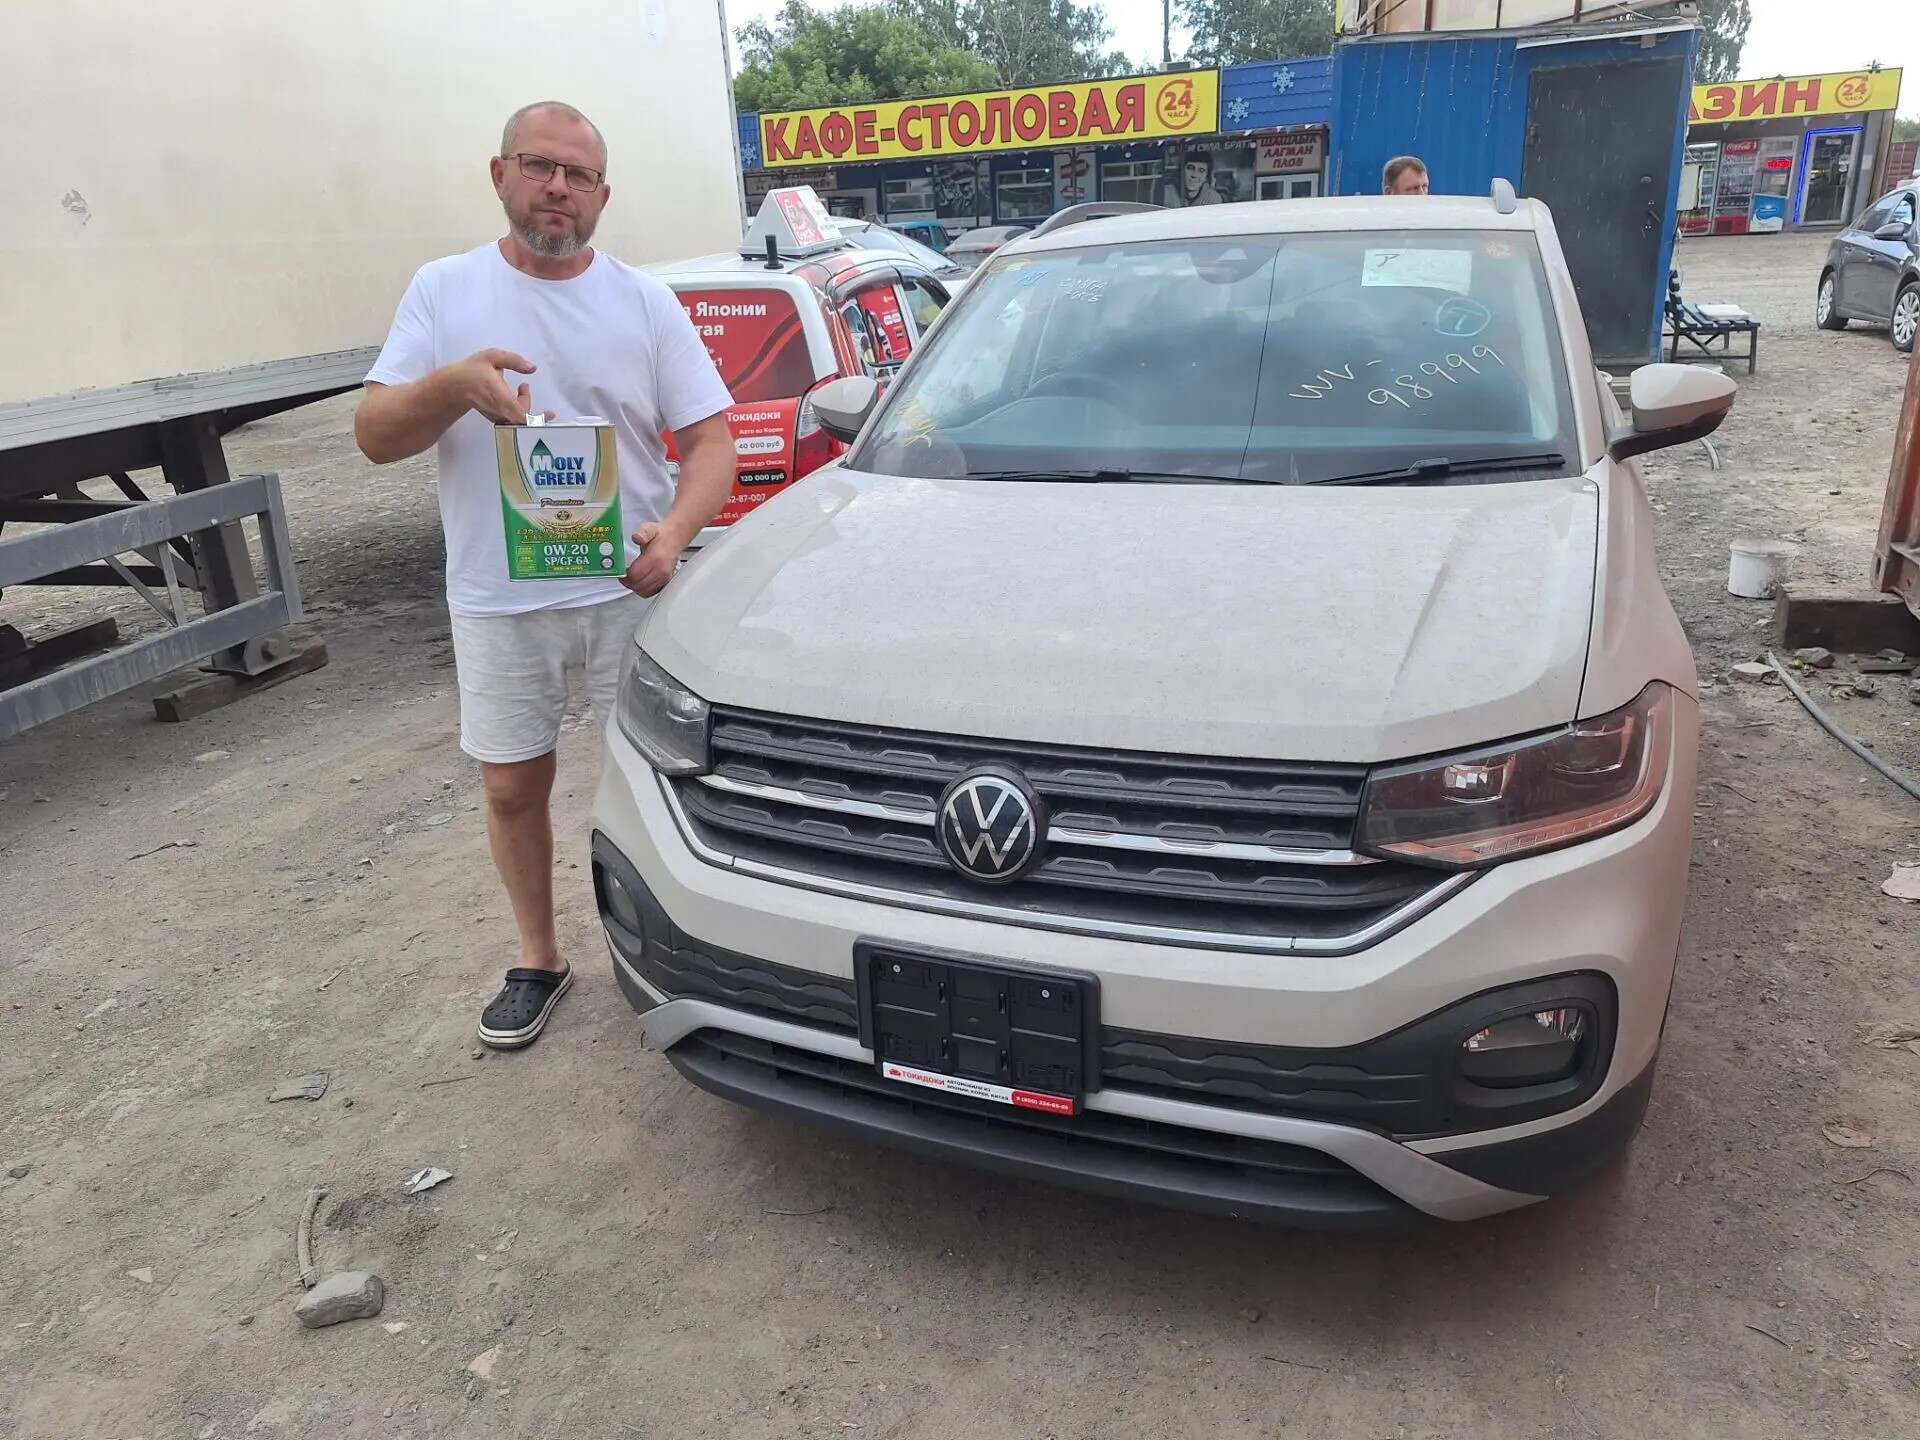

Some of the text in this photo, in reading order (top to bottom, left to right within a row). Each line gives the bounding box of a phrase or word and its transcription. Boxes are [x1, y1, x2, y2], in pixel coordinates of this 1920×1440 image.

[1841, 83, 1868, 97] 24
[1164, 89, 1193, 111] 24
[1167, 111, 1190, 119] ЧАСА
[764, 83, 1146, 162] КАФЕ-СТОЛОВАЯ
[1264, 146, 1313, 158] ЛАГМАН
[1273, 158, 1304, 168] ПЛОВ
[696, 301, 767, 317] Японии
[1367, 344, 1505, 409] 98999
[726, 411, 781, 422] Токидоки
[766, 440, 780, 449] руб
[533, 454, 584, 472] MOLY
[535, 472, 586, 486] GREEN
[740, 473, 785, 482] 120 000 руб
[544, 556, 590, 567] SP/GF-6A
[902, 1070, 945, 1086] ТОКИДОКИ
